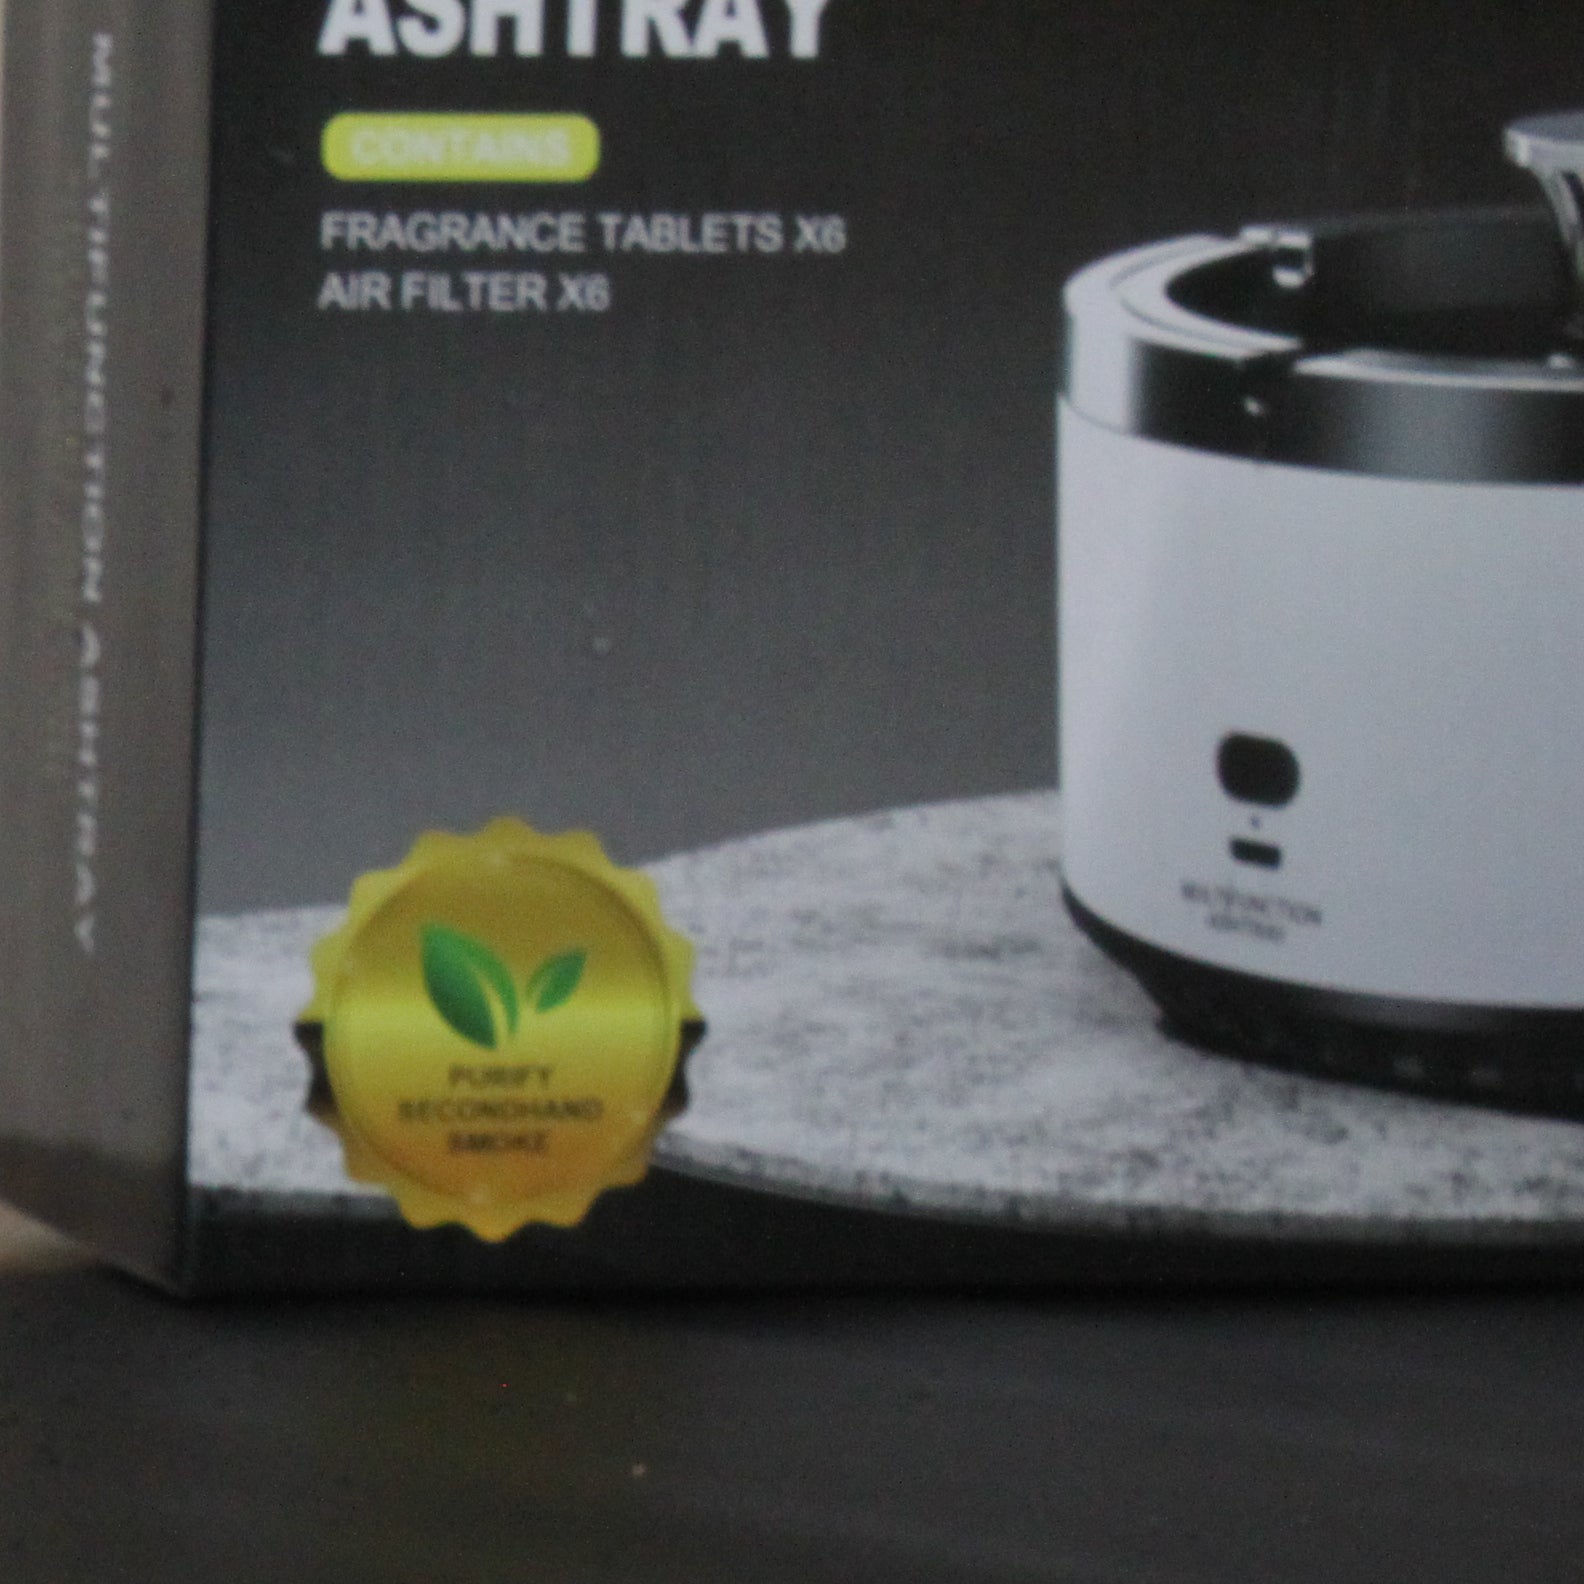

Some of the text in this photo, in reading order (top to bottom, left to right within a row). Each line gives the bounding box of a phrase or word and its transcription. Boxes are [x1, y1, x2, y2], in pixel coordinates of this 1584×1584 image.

[317, 0, 832, 58] ASHTRAY
[350, 128, 572, 168] CONTAINS
[319, 211, 847, 254] FRAGRANCE TABLETS X6
[318, 273, 611, 312] AIR FILTER X6
